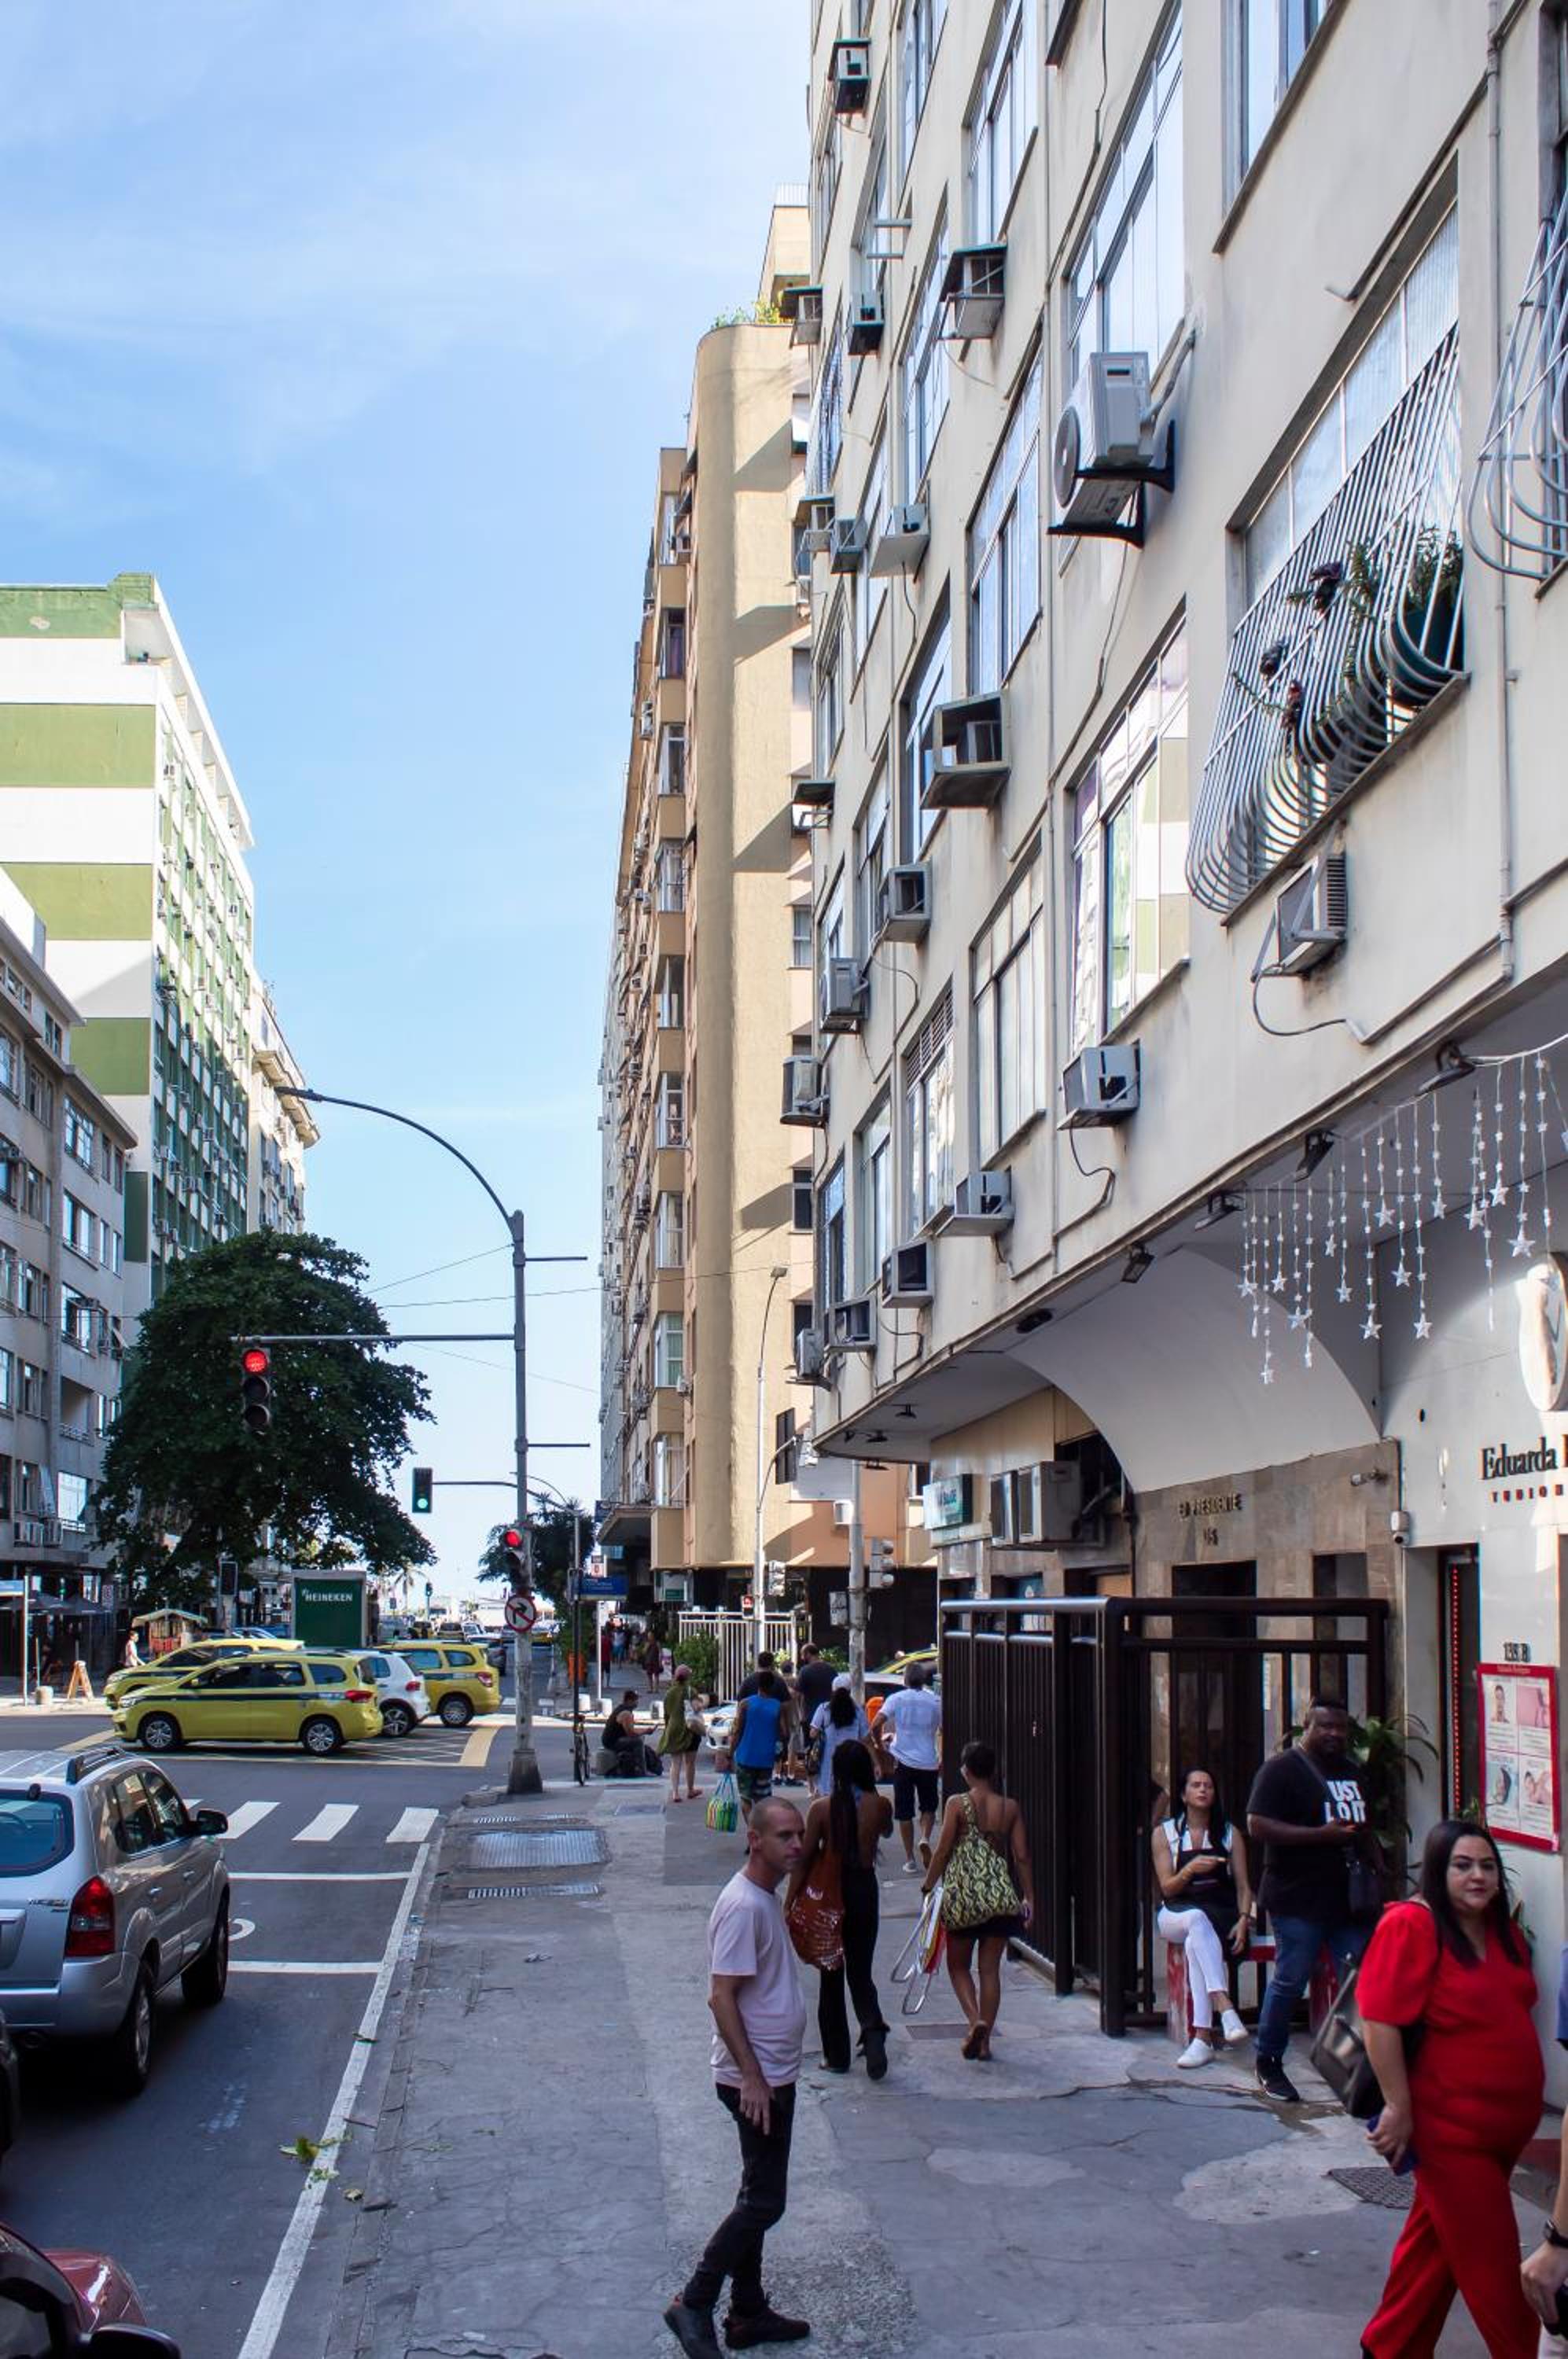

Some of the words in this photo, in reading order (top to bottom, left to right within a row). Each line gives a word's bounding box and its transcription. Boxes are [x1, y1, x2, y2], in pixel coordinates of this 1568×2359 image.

[1482, 1436, 1558, 1480] Eduarda
[305, 1592, 353, 1602] HEINEKEN
[1327, 1780, 1361, 1801] UST
